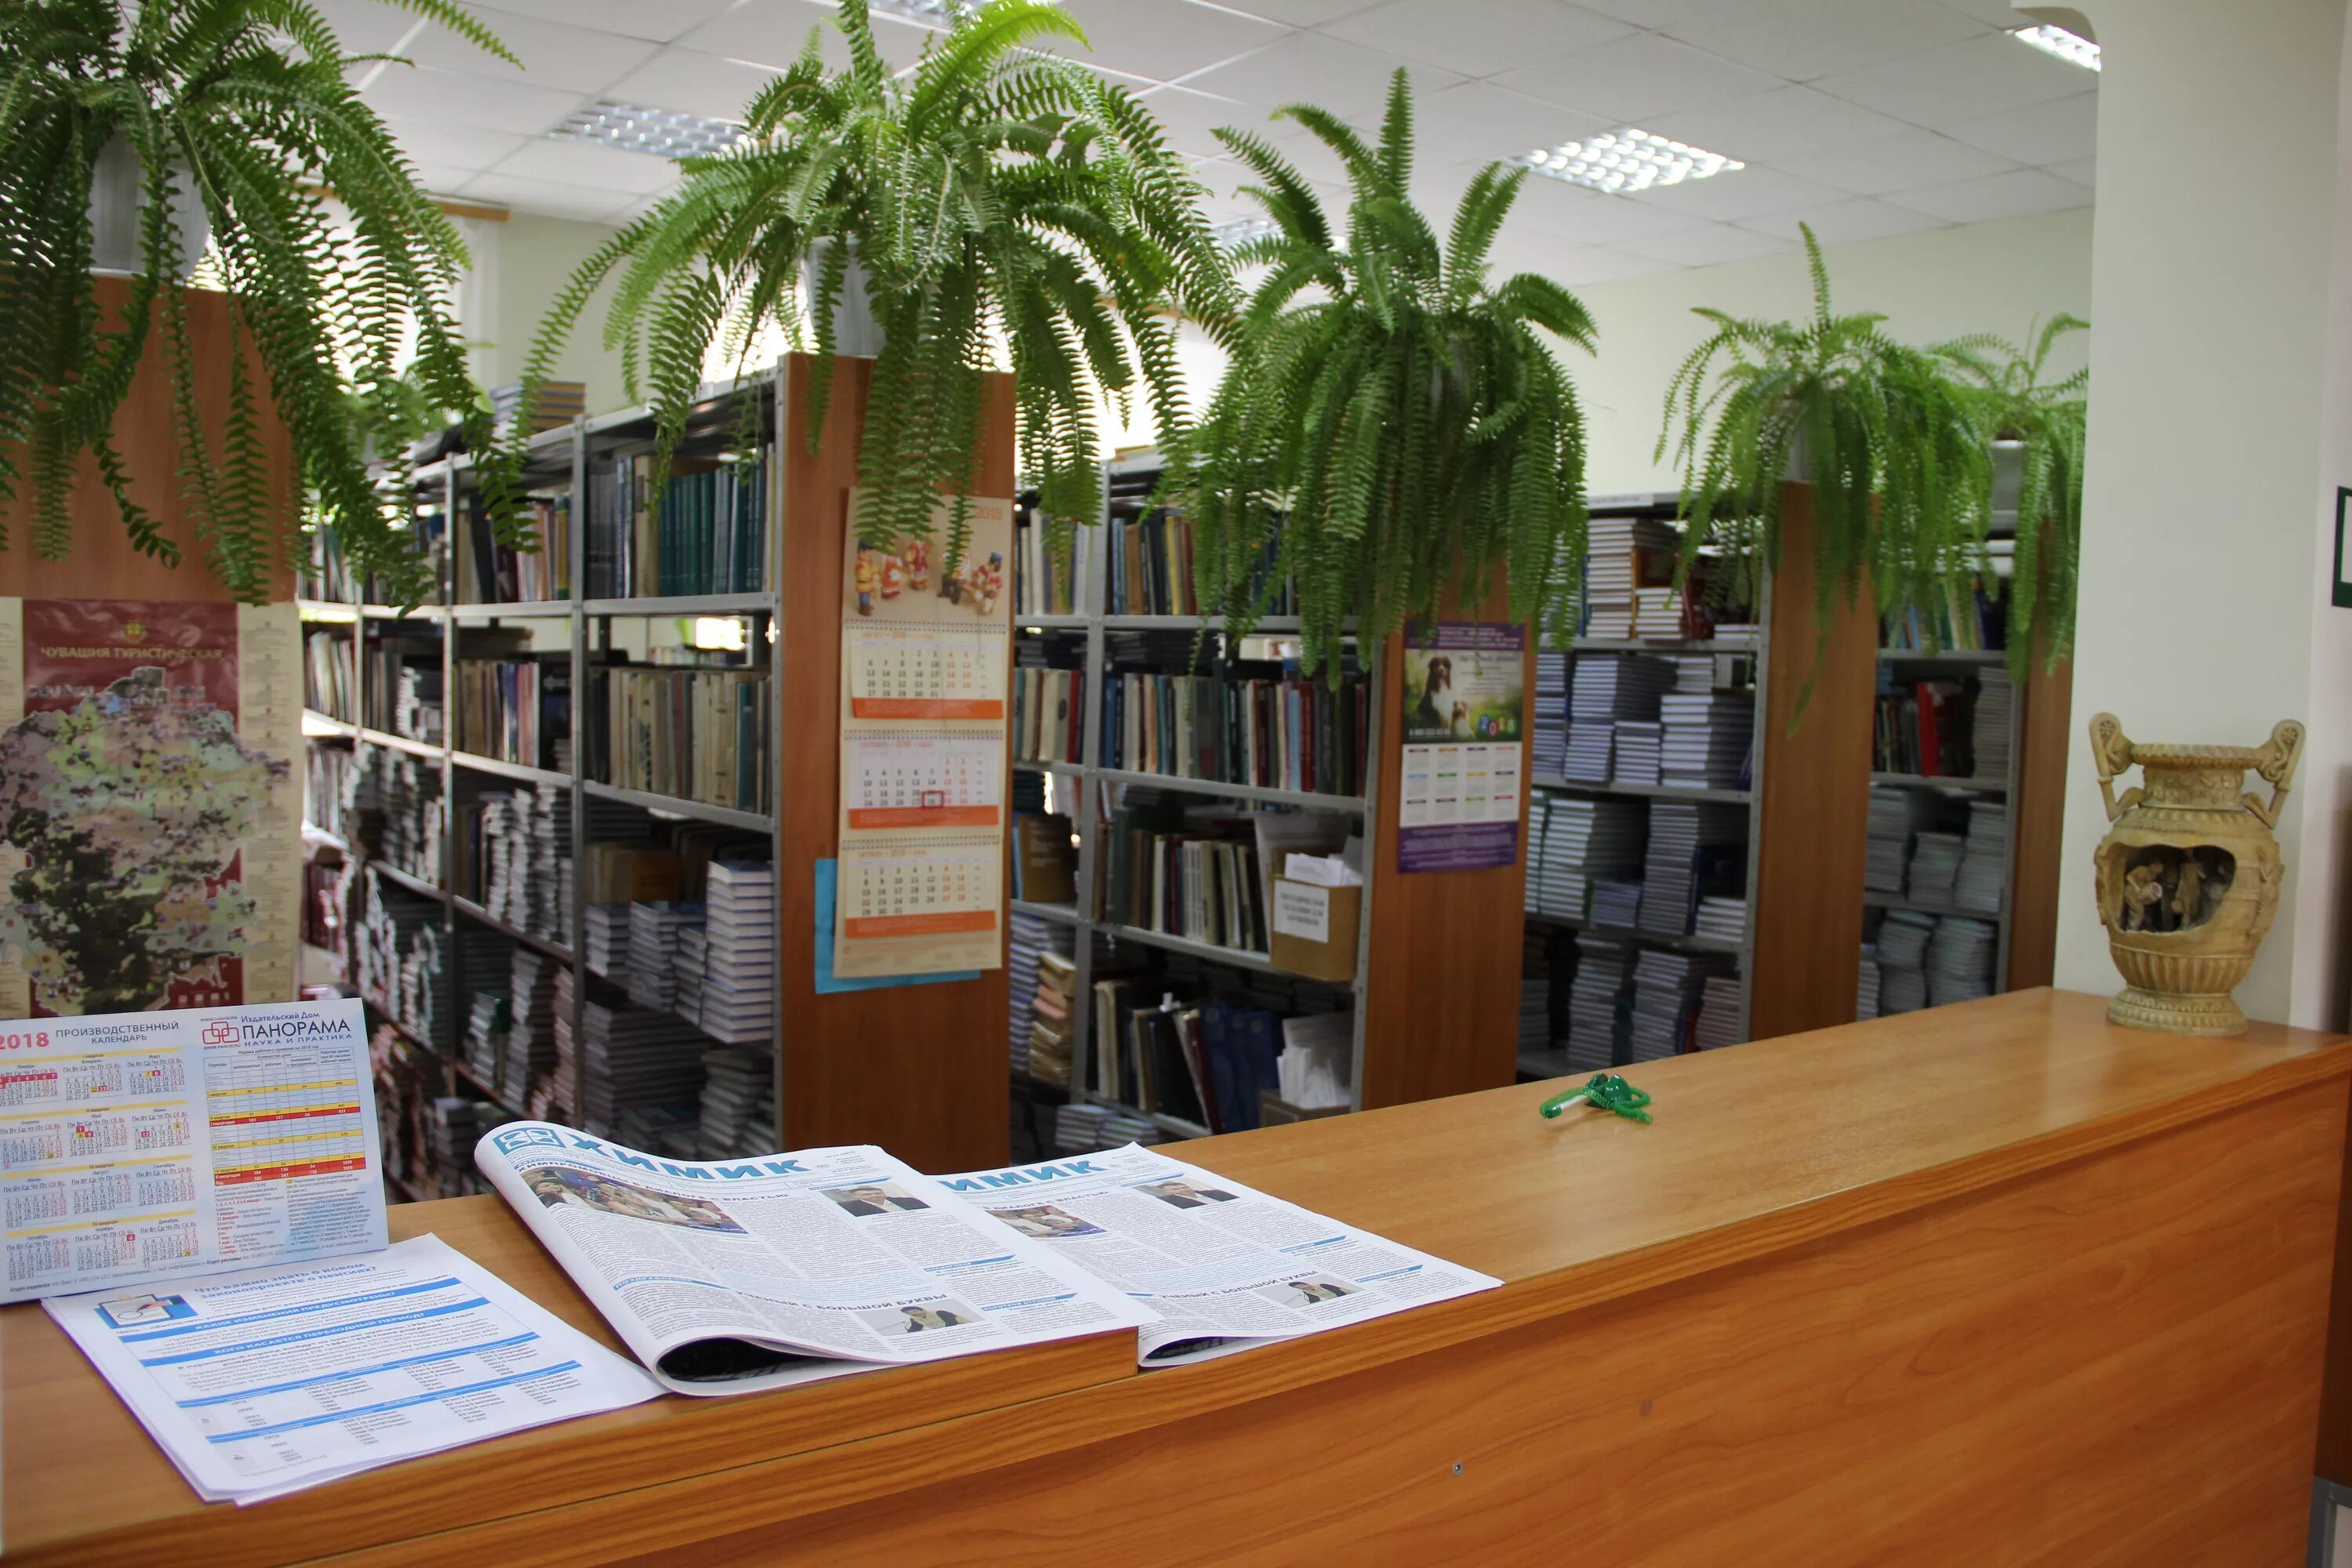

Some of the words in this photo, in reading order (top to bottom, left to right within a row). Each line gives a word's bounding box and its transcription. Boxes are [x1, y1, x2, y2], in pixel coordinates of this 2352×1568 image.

[41, 647, 111, 659] ЧУВАШИЯ
[114, 647, 222, 659] ТУРИСТИЧЕСКАЯ
[241, 1013, 299, 1022] Издательский
[56, 1021, 179, 1038] ПРОИЗВОДСТВЕННЫЙ
[242, 1018, 350, 1039] ПАНОРАМА
[298, 1033, 352, 1042] ПРАКТИКА
[0, 1032, 49, 1050] 2018
[92, 1035, 147, 1045] КАЛЕНДАРЬ
[564, 1132, 812, 1180] ХИМИК
[518, 1161, 630, 1183] ХИМПРОМОВЦЫ
[645, 1185, 706, 1200] ДИАЛОГЕ
[723, 1193, 789, 1202] ВЛАСТЬЮ
[938, 1160, 1108, 1191] ИМИК
[1056, 1191, 1109, 1202] ВЛАСТЬЮ
[201, 1279, 306, 1299] законопроекте
[318, 1266, 377, 1279] пенсиях?
[223, 1279, 263, 1290] важно
[272, 1272, 308, 1281] знать
[322, 1264, 365, 1273] новом
[1221, 1279, 1279, 1294] БОЛЬШОЙ
[1280, 1270, 1318, 1282] БУКВЫ
[195, 1320, 230, 1330] КАКИЕ
[234, 1308, 299, 1324] ИЗМЕНЕНИЯ
[301, 1291, 395, 1312] ПРЕДУСМОТРЕНЫ?
[816, 1301, 893, 1311] БОЛЬШОЙ
[896, 1294, 947, 1306] БУКВЫ
[214, 1345, 245, 1354] КОГО
[247, 1335, 301, 1348] КАСАЕТСЯ
[306, 1319, 378, 1338] ПЕРЕХОДНЫЙ
[379, 1312, 425, 1323] ПЕРИОД?
